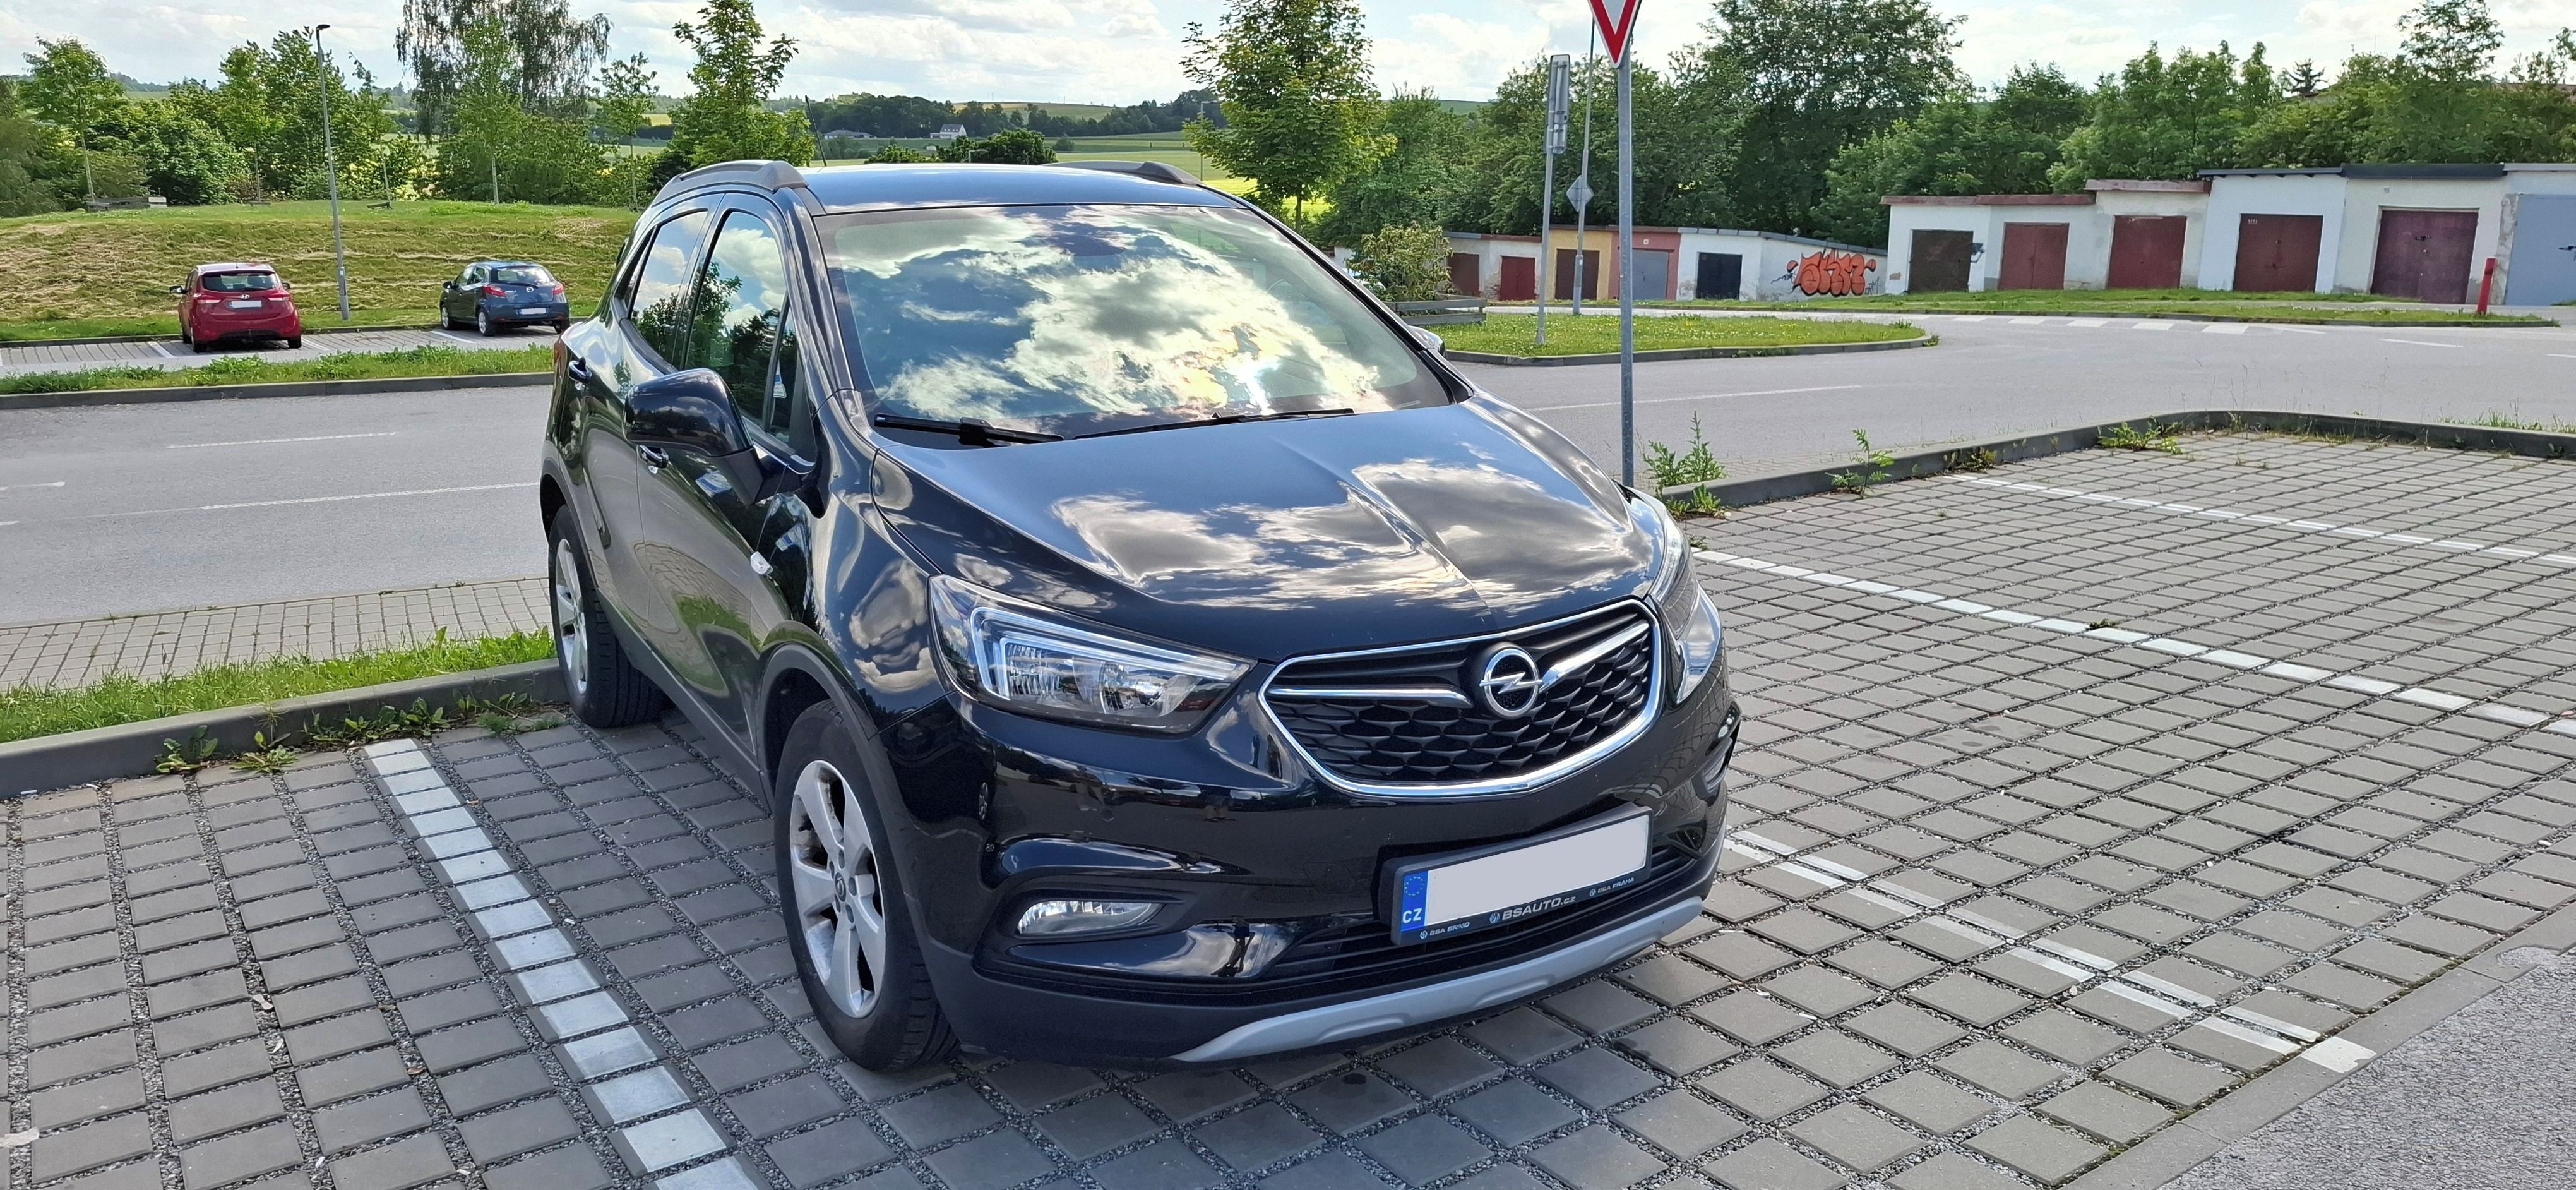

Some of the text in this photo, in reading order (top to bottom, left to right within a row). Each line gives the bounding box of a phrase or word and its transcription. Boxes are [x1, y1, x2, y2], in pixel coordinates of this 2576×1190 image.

[1402, 908, 1422, 923] CZ
[1502, 896, 1576, 920] BSAUTO.cz
[1447, 922, 1470, 932] BRNO
